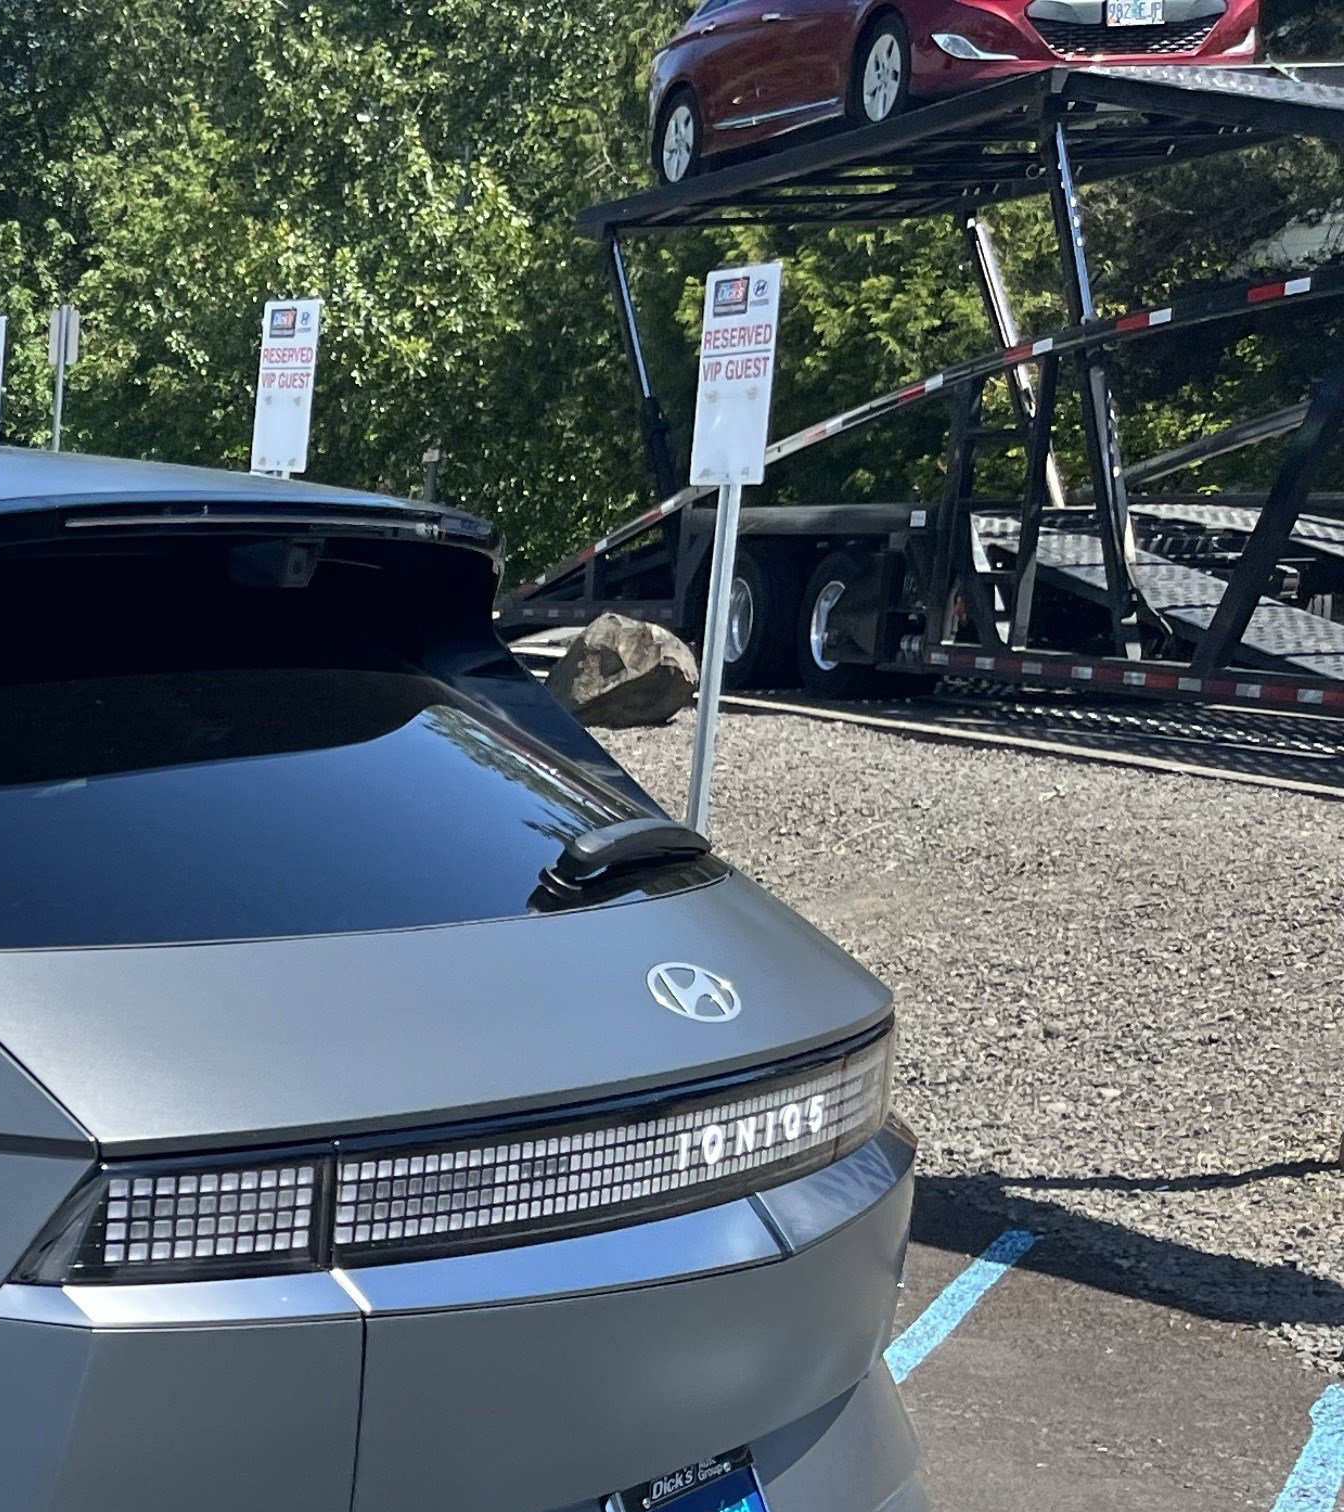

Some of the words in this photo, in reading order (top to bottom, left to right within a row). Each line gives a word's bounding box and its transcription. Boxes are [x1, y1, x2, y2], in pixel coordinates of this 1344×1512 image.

[703, 324, 773, 350] RESERVED
[263, 347, 314, 363] RESERVED
[262, 372, 276, 388] VIP
[278, 372, 312, 388] GUEST
[702, 361, 722, 382] VIP
[725, 357, 770, 380] GUEST
[652, 1468, 693, 1500] Dick's
